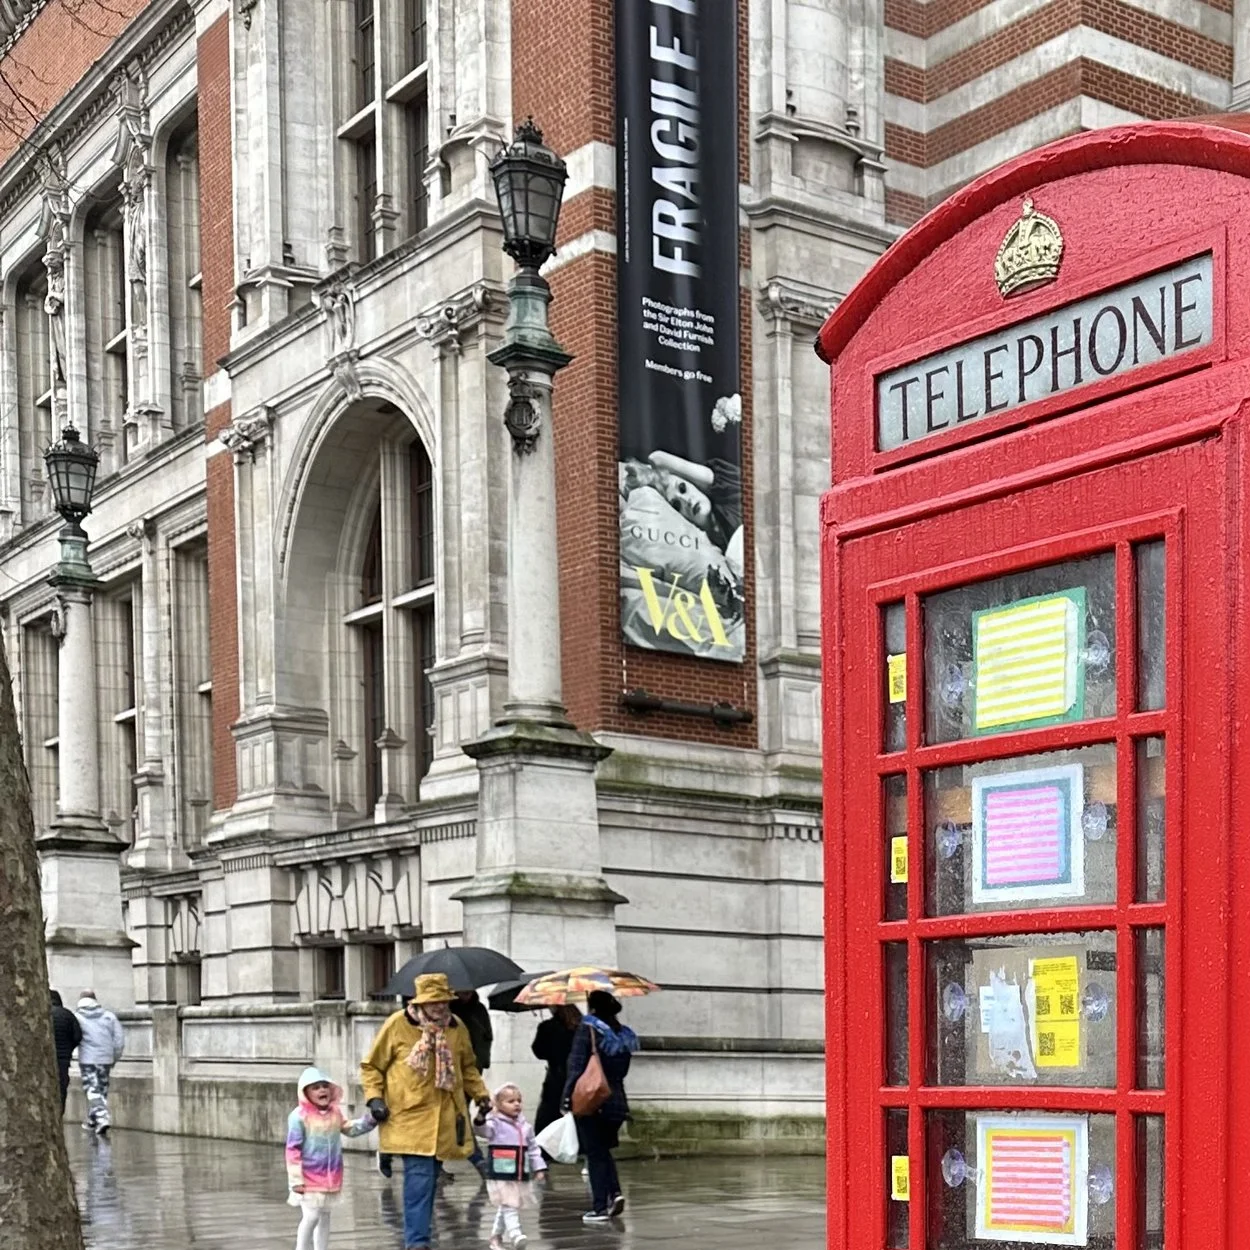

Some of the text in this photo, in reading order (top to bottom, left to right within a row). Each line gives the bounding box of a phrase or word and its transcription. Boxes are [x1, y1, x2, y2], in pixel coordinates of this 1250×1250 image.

[650, 25, 701, 279] FRAGILE
[642, 296, 715, 323] Photographs from
[643, 309, 714, 334] the Sir Elton John
[643, 321, 714, 345] and David Furnish
[658, 335, 700, 352] Collection
[889, 273, 1203, 441] TELEPHONE
[645, 359, 713, 383] Members go free
[630, 525, 700, 550] GUCCI
[631, 566, 735, 648] V&A
